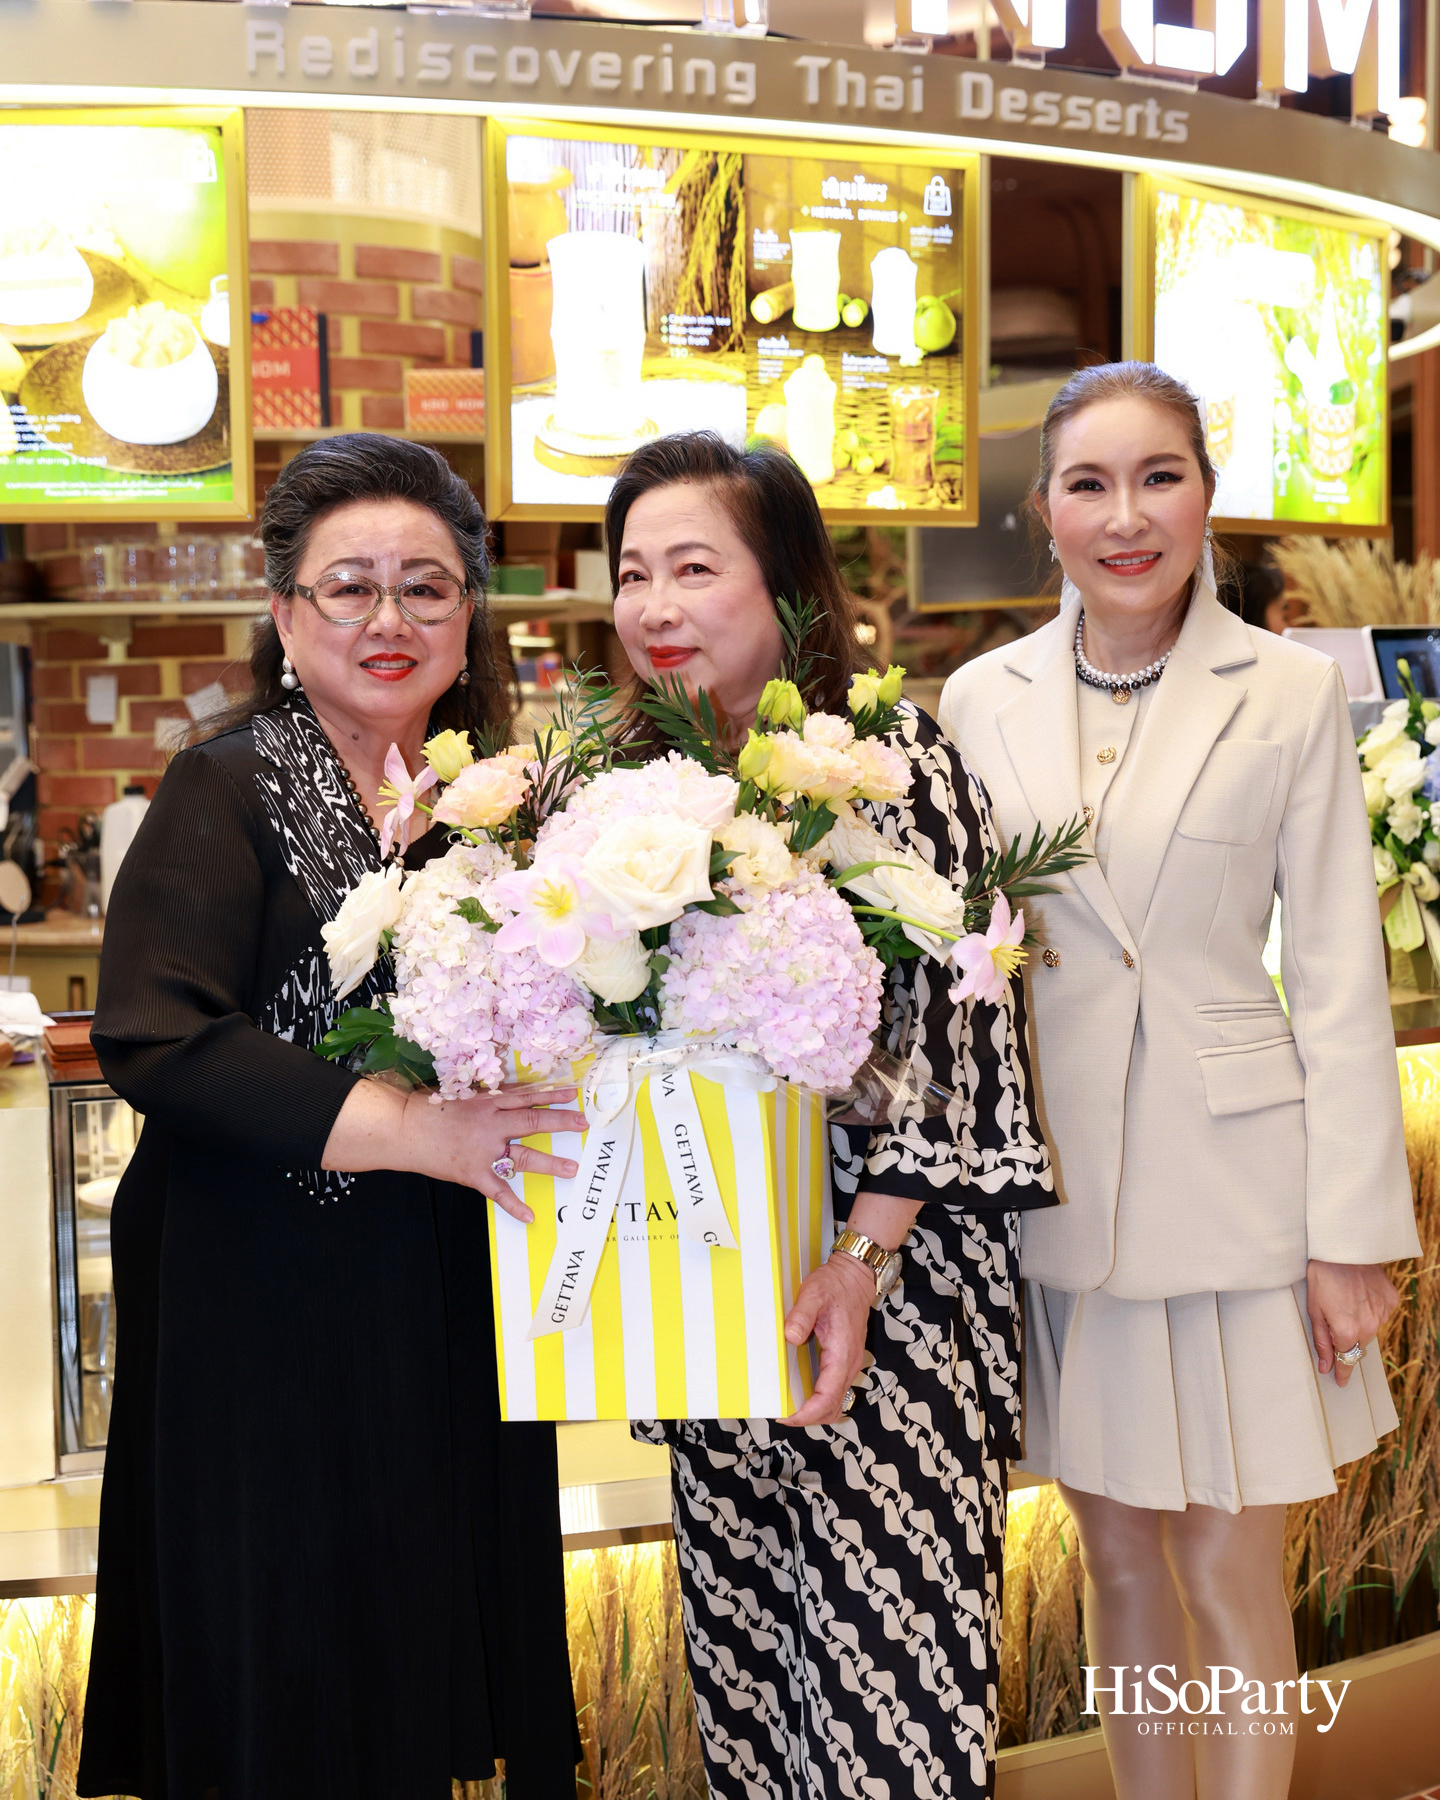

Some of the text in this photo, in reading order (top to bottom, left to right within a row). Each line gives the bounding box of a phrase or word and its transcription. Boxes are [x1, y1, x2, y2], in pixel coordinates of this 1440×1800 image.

[245, 19, 1191, 143] Rediscovering Thai Desserts
[810, 206, 899, 223] HERBAL DRINKS
[581, 1139, 616, 1221] GETTAVA
[674, 1123, 705, 1207] GETTAVA
[551, 1249, 586, 1324] GETTAVA
